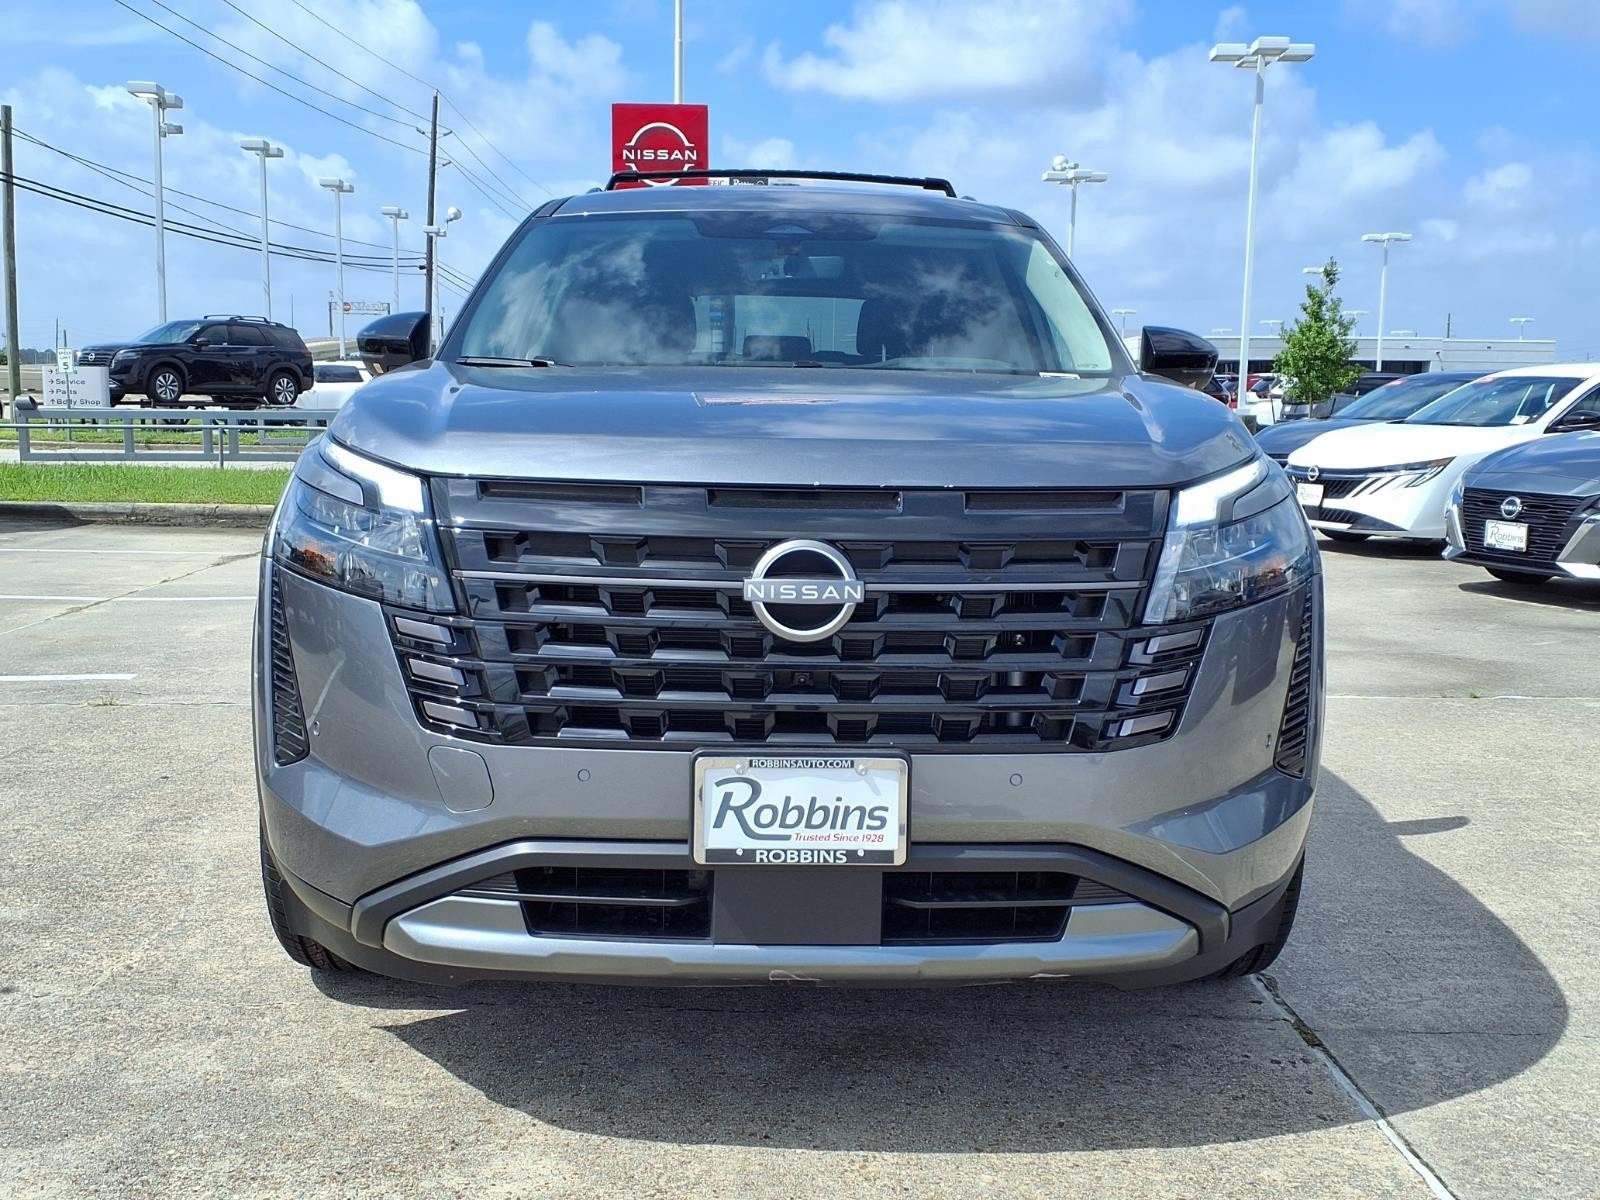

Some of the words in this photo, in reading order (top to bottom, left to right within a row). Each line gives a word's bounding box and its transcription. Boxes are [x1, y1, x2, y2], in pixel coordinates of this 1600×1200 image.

[622, 149, 697, 161] NISSAN
[1490, 525, 1525, 544] Robbins
[747, 584, 861, 600] NISSAN
[752, 759, 852, 769] ROBBINSAUTO.COM
[712, 776, 889, 841] Robbins
[794, 832, 831, 842] Trusted
[833, 832, 860, 843] Since
[862, 833, 885, 843] 1928
[755, 850, 848, 864] ROBBINS
